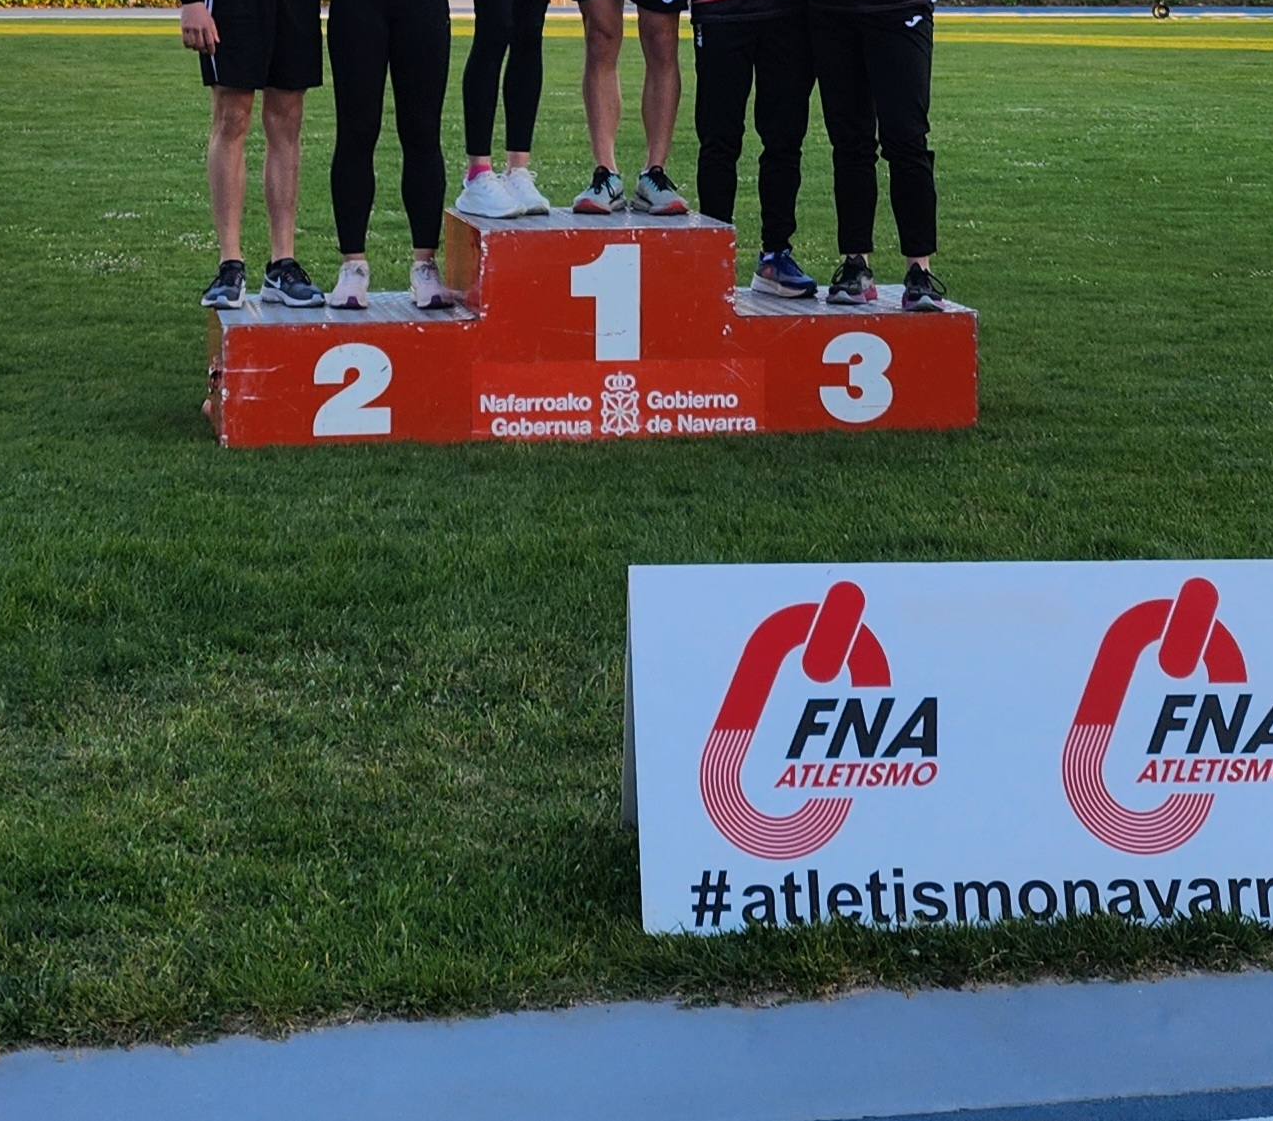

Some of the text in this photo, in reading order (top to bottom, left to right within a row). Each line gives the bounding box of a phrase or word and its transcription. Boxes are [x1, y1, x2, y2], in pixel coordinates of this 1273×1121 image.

[571, 244, 640, 361] 1
[313, 342, 392, 436] 2
[819, 331, 893, 423] 3
[480, 393, 592, 413] Nafarroako
[647, 391, 738, 409] Gobierno
[491, 417, 591, 436] Gobernua
[647, 415, 756, 433] de Navarra
[786, 697, 938, 759] FNA
[775, 762, 938, 789] ATLETISMO
